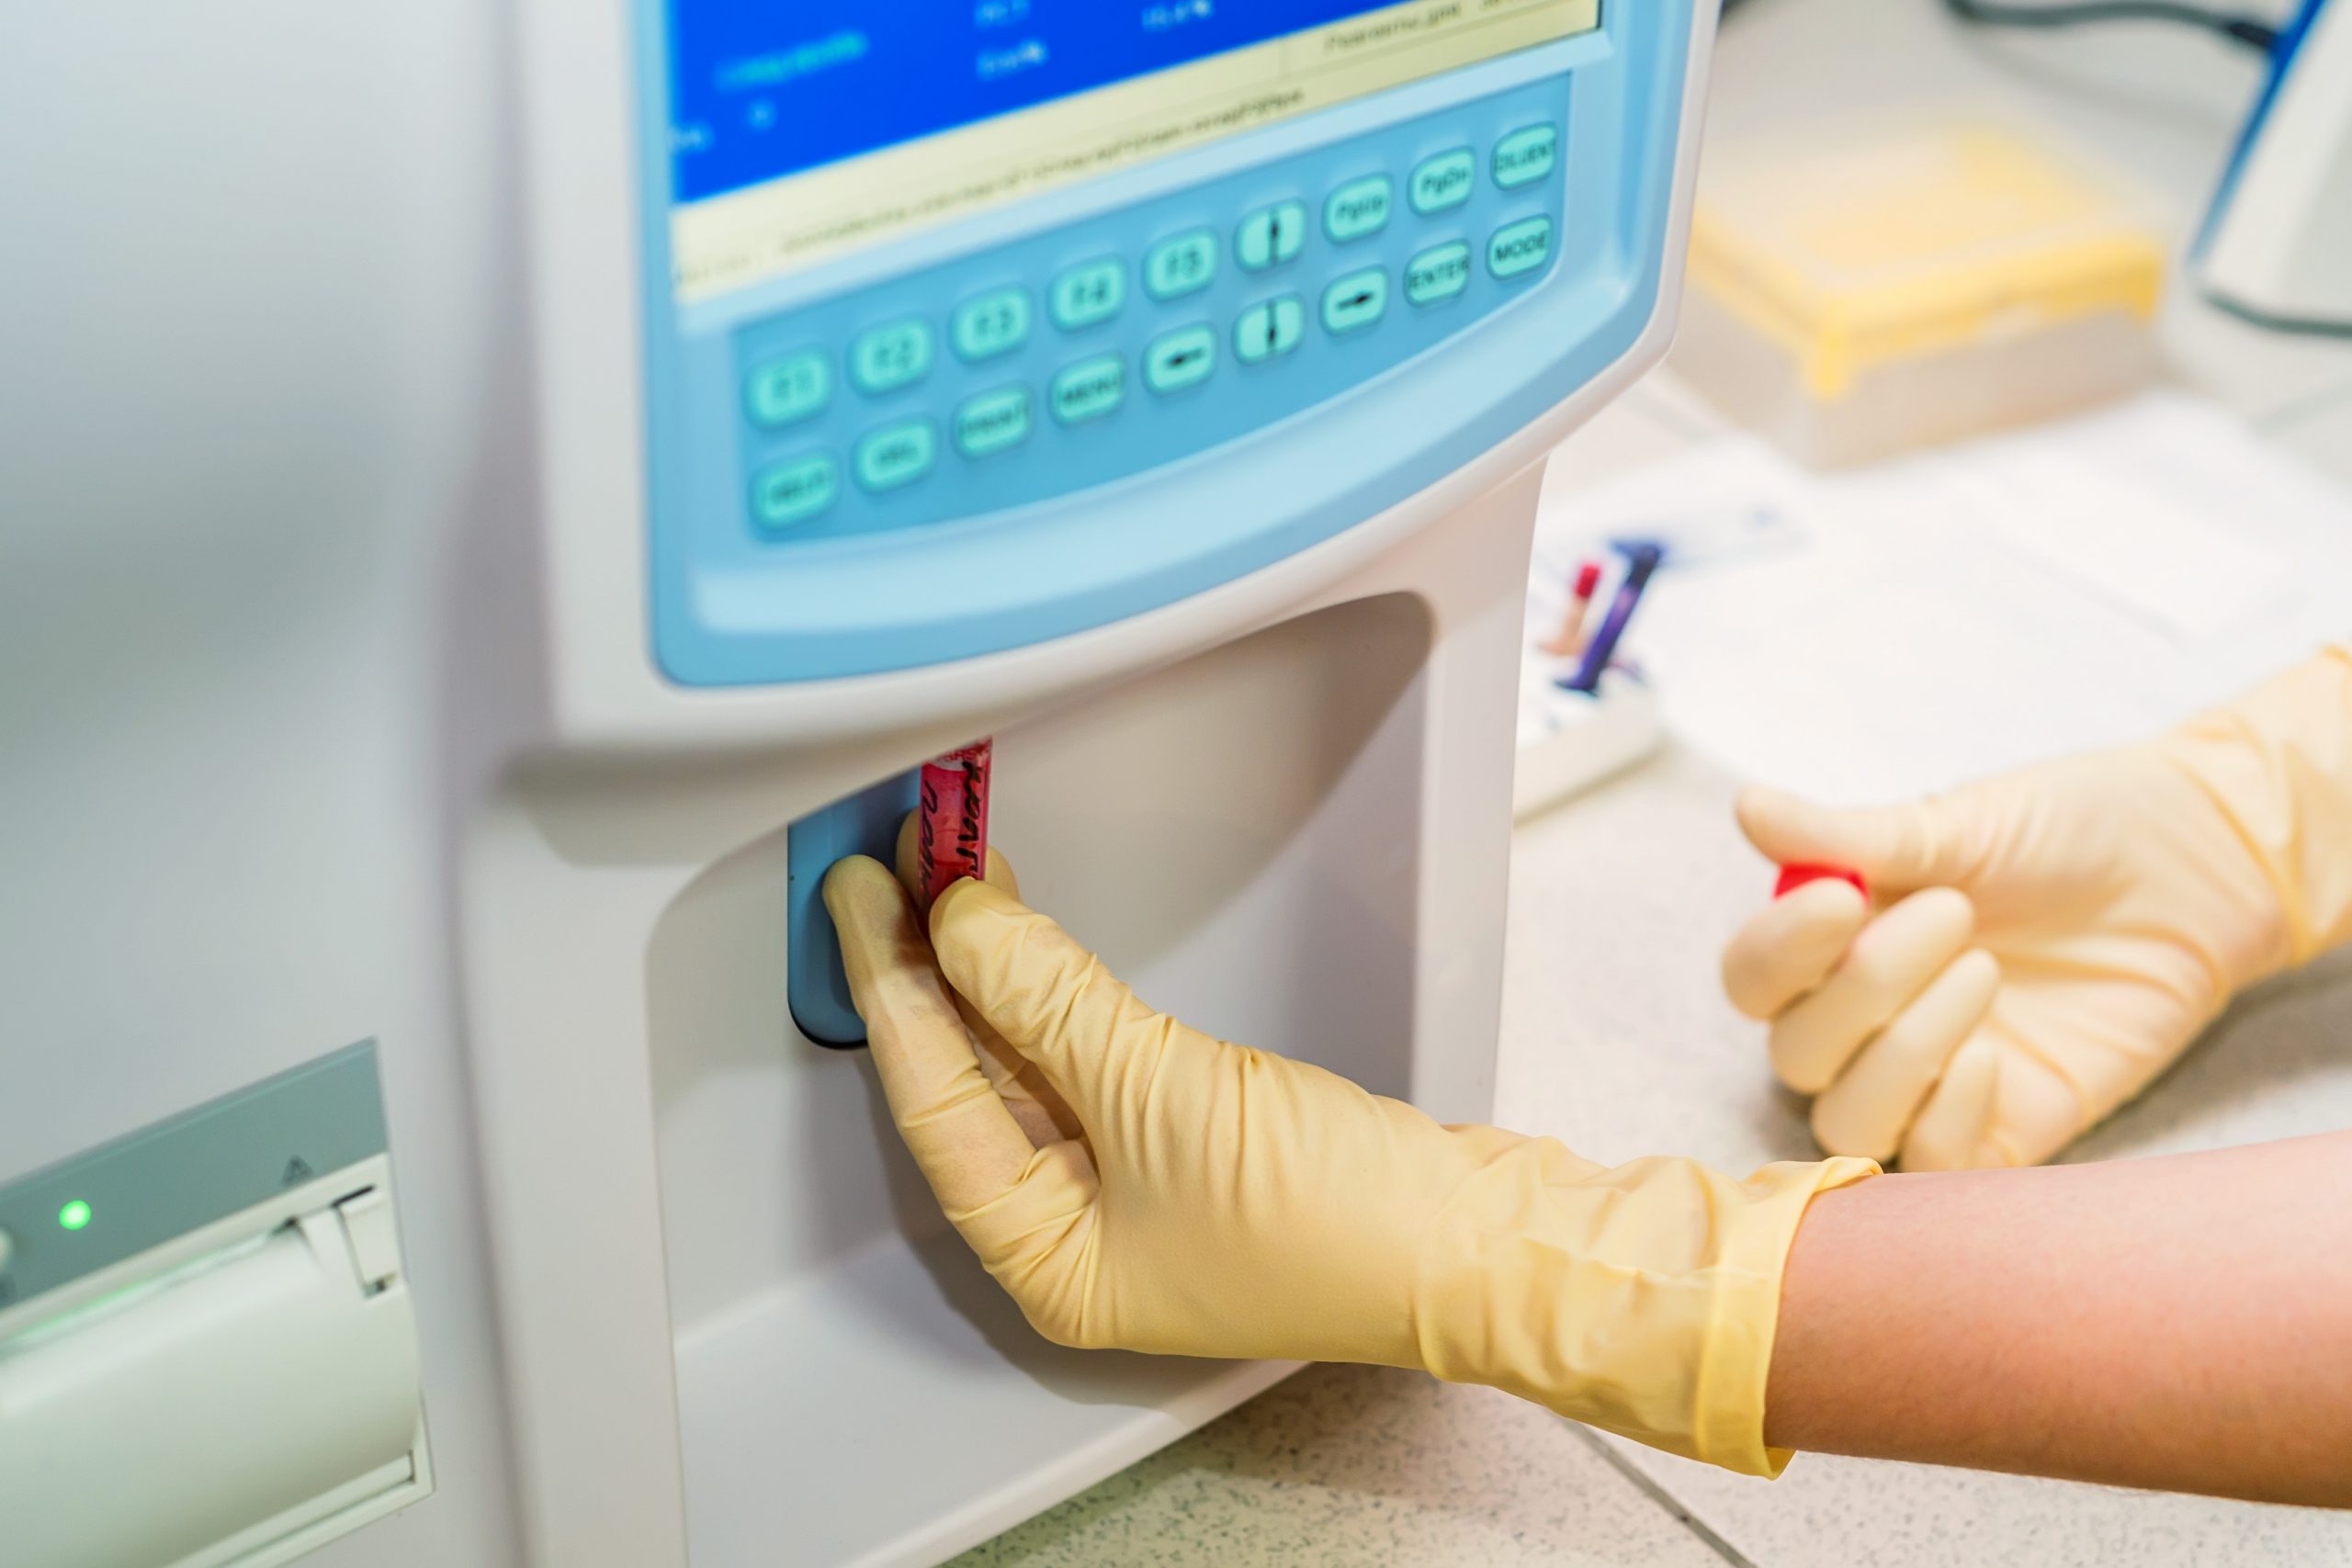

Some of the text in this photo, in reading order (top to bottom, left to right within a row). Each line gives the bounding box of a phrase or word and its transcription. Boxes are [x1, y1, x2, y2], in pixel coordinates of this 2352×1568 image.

[1419, 167, 1469, 198] PgDn
[1493, 231, 1551, 262] MODE
[1407, 254, 1470, 290] ENTER
